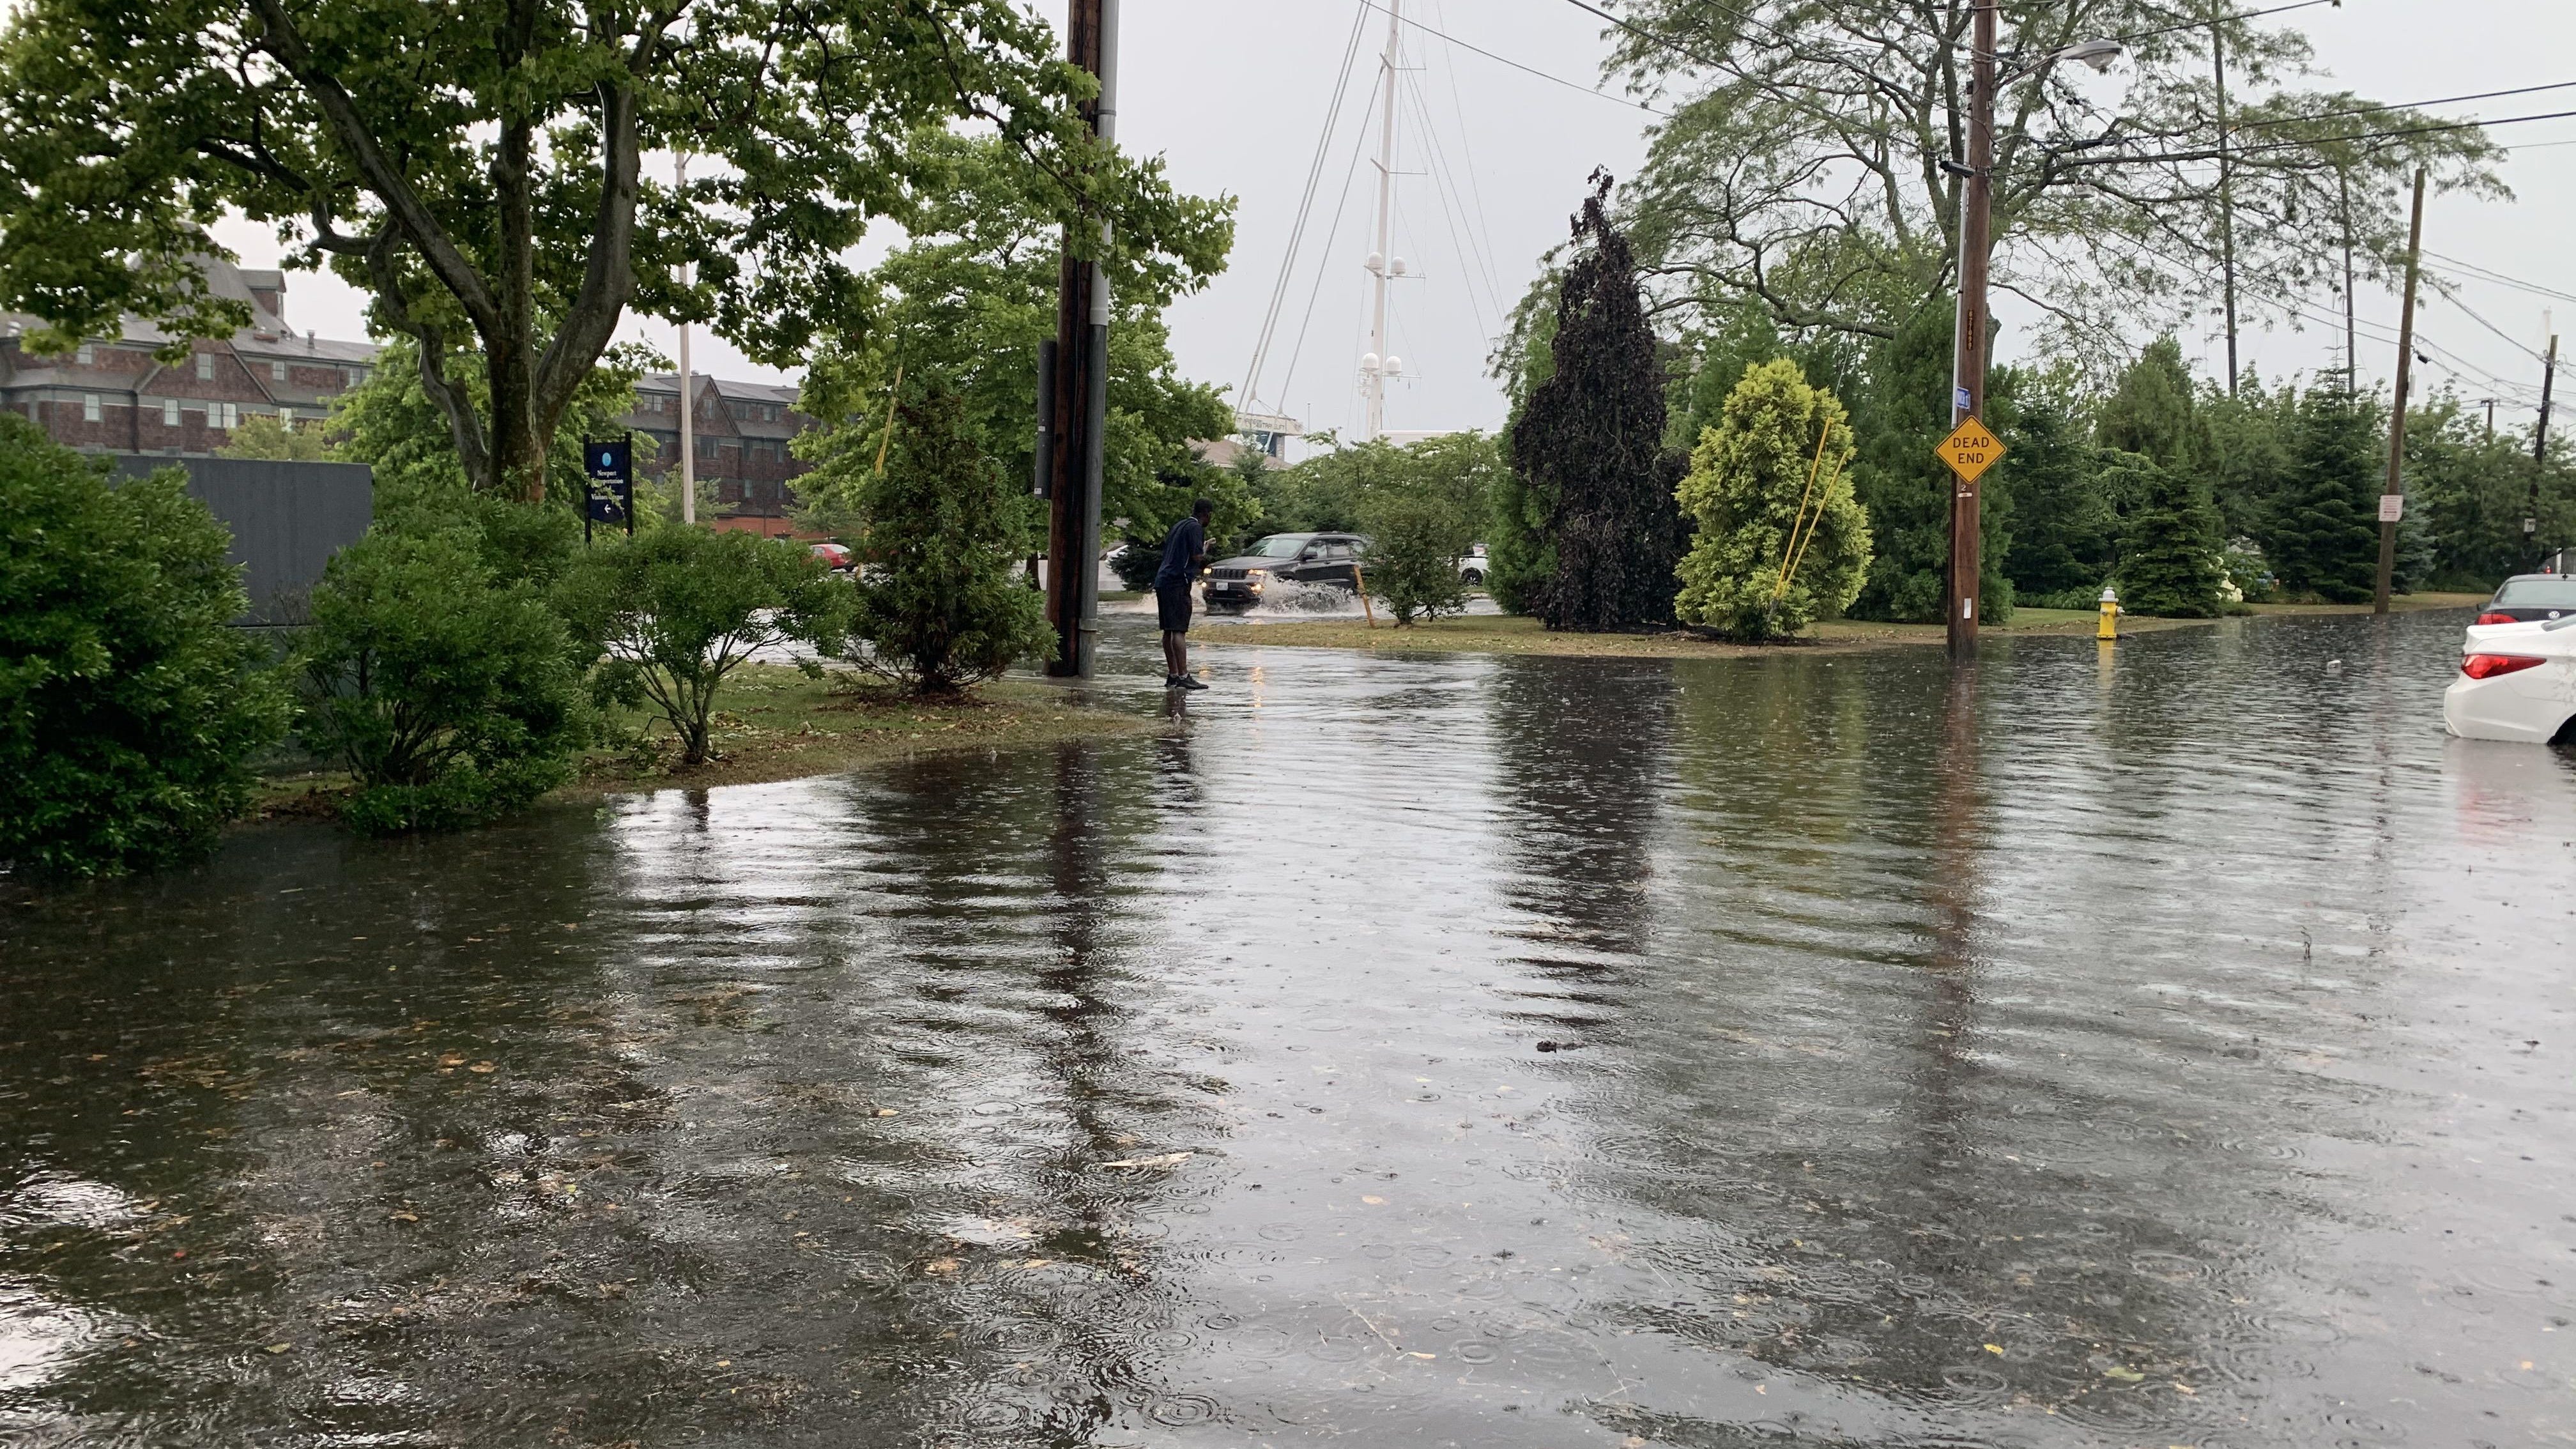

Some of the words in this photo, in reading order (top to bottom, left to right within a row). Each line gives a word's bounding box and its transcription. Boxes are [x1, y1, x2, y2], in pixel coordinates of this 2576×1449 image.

[1953, 437, 1989, 448] DEAD
[1958, 453, 1984, 464] END
[597, 470, 617, 478] Newport
